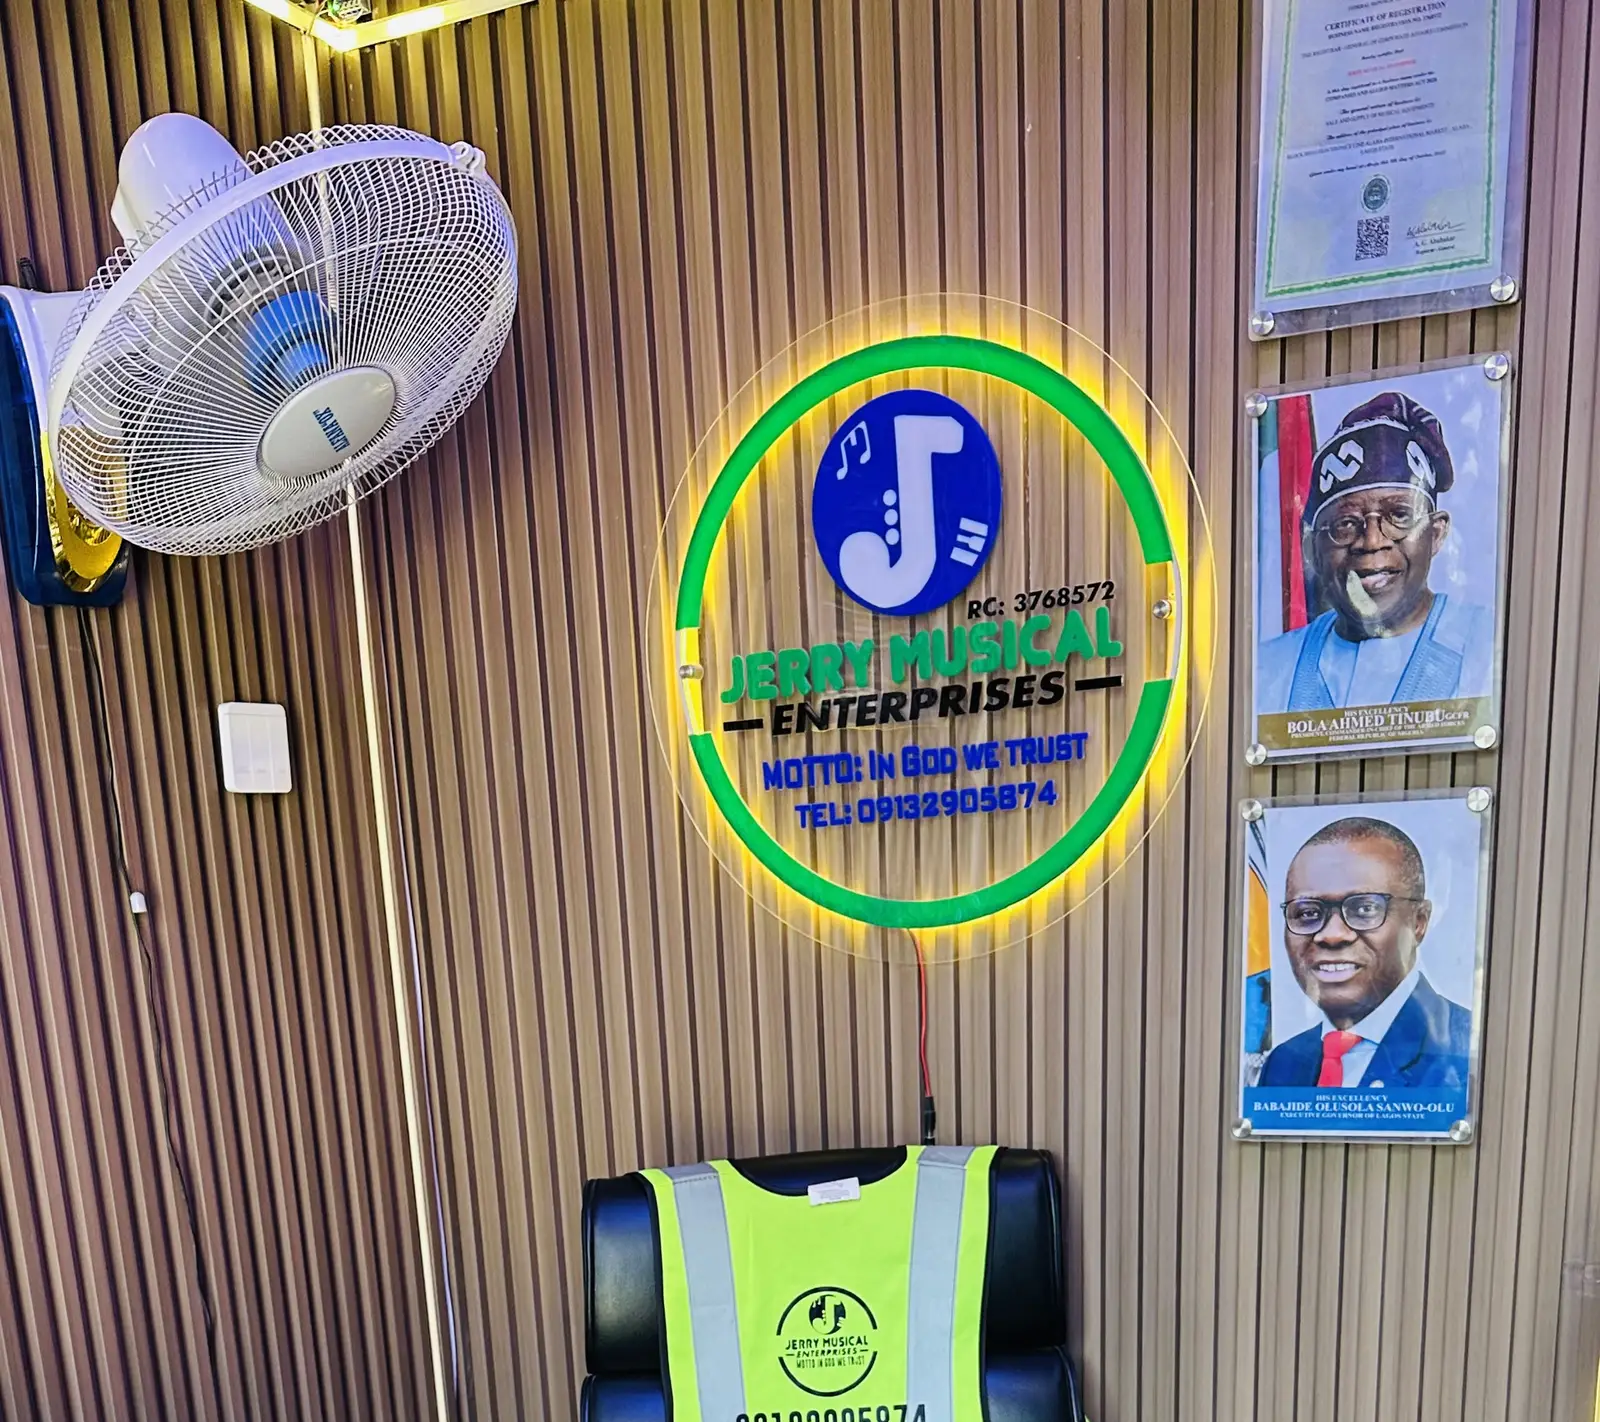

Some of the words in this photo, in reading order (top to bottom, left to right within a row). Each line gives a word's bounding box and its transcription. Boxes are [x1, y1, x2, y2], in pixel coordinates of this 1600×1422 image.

[1325, 16, 1374, 31] CERTIFICATE
[1388, 0, 1447, 18] REGISTRATION
[968, 597, 1005, 619] RC:
[1014, 581, 1115, 613] 3768572
[721, 639, 875, 704] JERRY
[889, 606, 1123, 684] MUSICAL
[772, 671, 1065, 736] ENTERPRISES
[1358, 706, 1408, 716] EXCELLENCY
[1287, 720, 1327, 733] BOLA
[1329, 714, 1385, 730] AHMED
[1387, 709, 1445, 725] TINUBU
[1445, 711, 1470, 720] GCFR
[763, 752, 862, 790] MOTTO:
[795, 803, 851, 828] TEL:
[857, 780, 1057, 824] 09132905874
[1254, 1101, 1313, 1112] BABAJIDE
[1315, 1102, 1374, 1112] OLUSOLA
[1376, 1102, 1455, 1113] SANWO-OLU
[785, 1339, 820, 1350] JERRY
[823, 1335, 868, 1348] MUSICAL
[796, 1347, 858, 1358] ENTERPRISES
